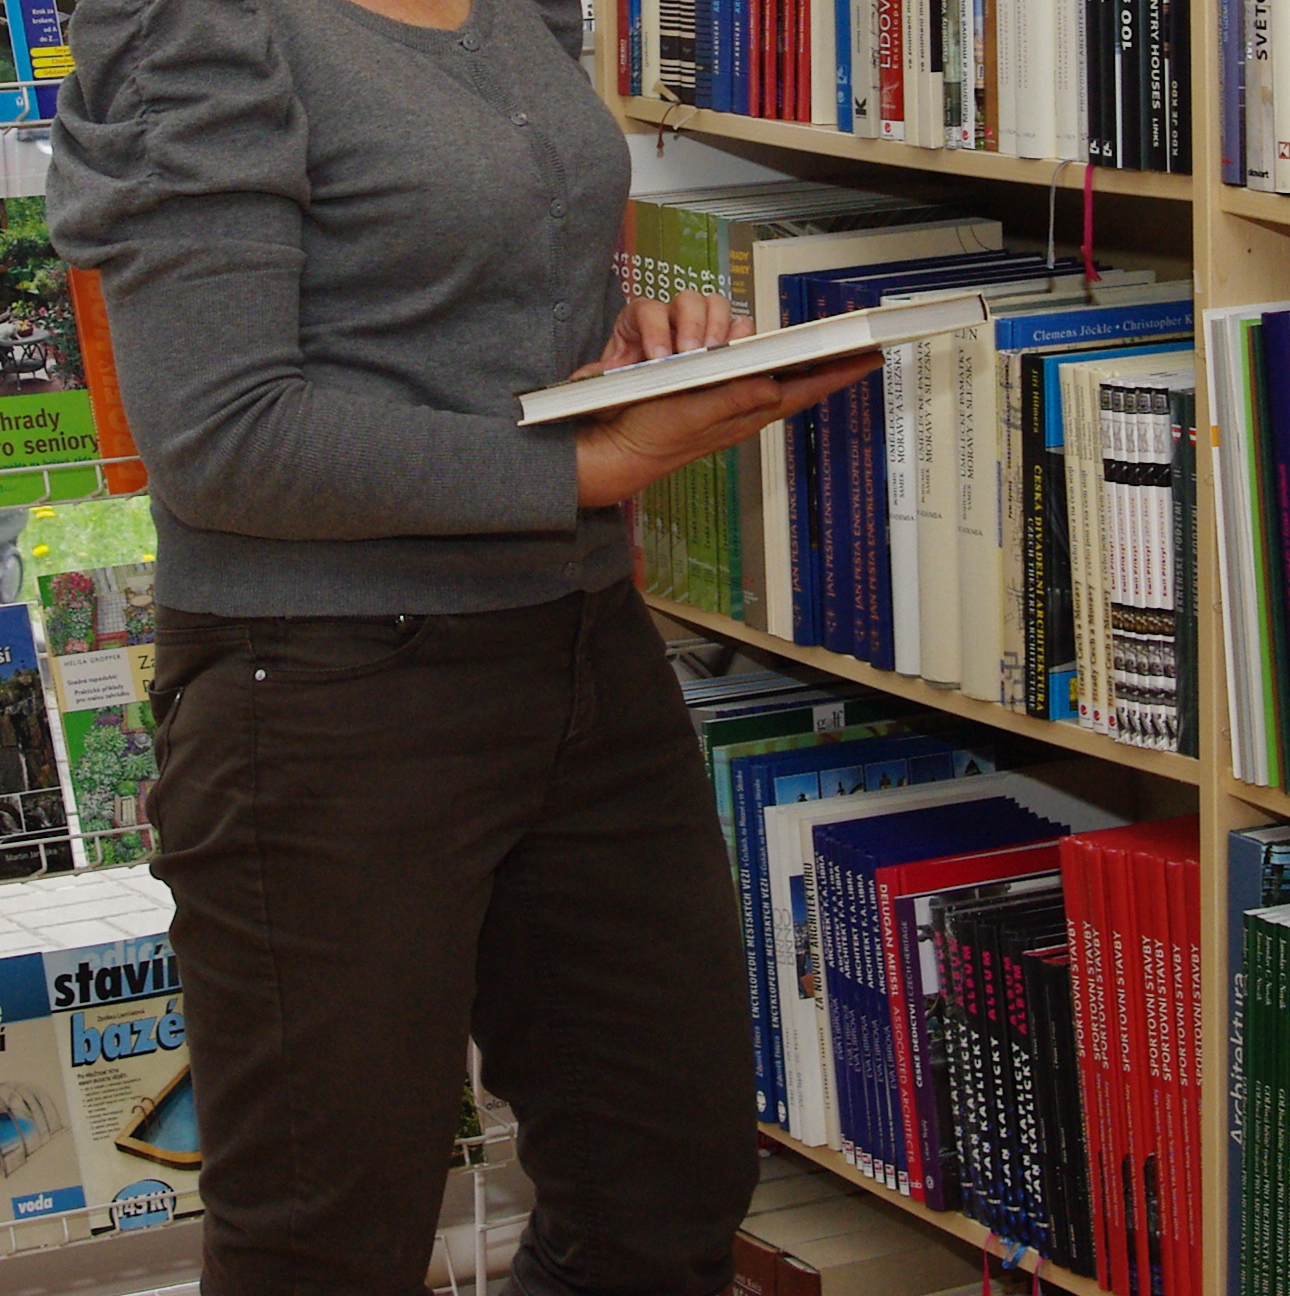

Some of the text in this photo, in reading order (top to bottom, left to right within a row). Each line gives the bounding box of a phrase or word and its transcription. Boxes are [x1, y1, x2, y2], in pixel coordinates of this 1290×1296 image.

[1121, 9, 1132, 51] 100
[1150, 45, 1161, 110] HOUSES
[1033, 323, 1113, 342] Clemens Jöckle
[24, 431, 99, 456] seniory
